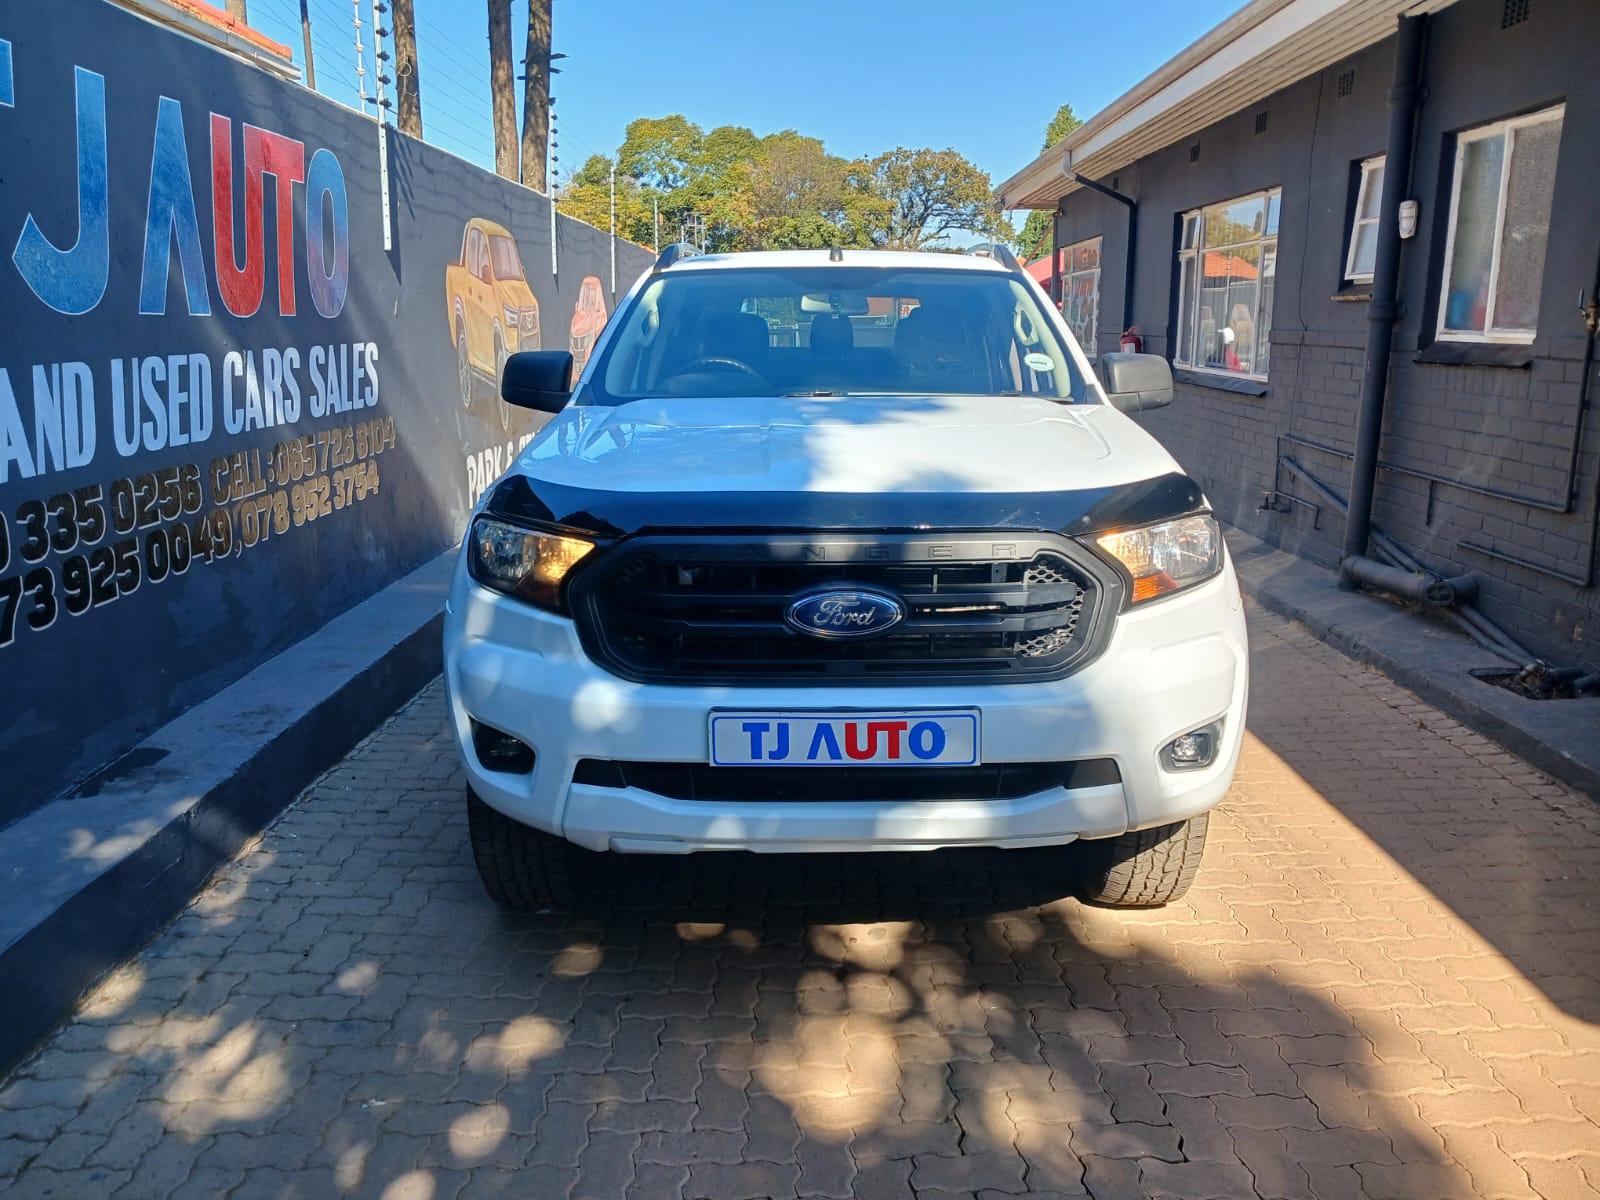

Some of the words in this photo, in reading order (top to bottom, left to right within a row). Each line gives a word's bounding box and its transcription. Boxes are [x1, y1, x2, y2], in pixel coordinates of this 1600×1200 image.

[139, 95, 349, 319] AUTO
[0, 362, 96, 484] AND
[111, 353, 213, 457] USED
[223, 347, 301, 435] CARS
[309, 342, 379, 418] SALES
[16, 484, 106, 564] 335
[111, 464, 202, 535] 0256
[466, 445, 502, 510] PARK
[62, 536, 142, 617] 925
[291, 473, 332, 527] 952
[333, 459, 380, 510] 3754
[813, 599, 876, 627] Ford
[742, 722, 790, 760] TJ
[806, 720, 946, 761] AUTO
